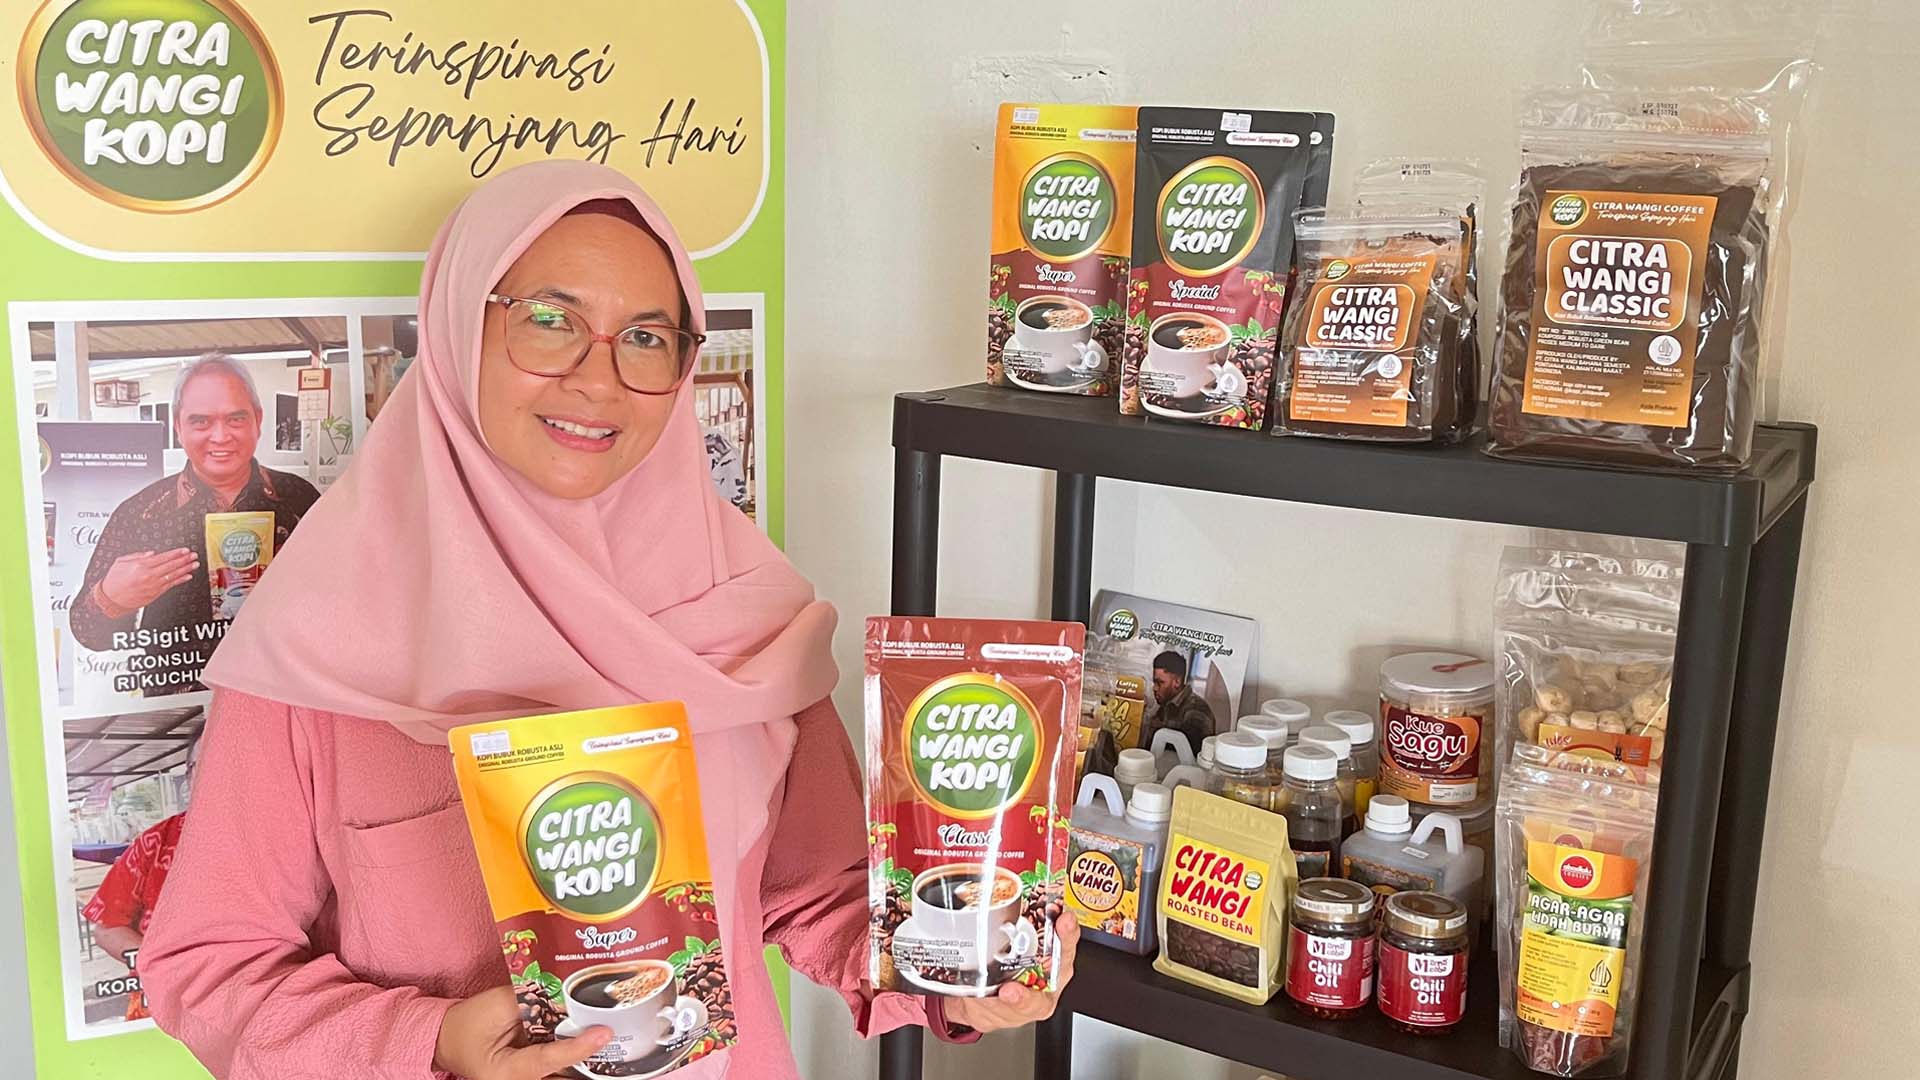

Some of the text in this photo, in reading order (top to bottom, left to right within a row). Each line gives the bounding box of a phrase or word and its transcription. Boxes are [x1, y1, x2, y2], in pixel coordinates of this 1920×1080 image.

[65, 19, 230, 67] CITRA
[307, 9, 615, 99] Terinspirasi
[55, 72, 244, 116] WANGI
[313, 83, 747, 178] Sepanjang Hari
[83, 119, 226, 168] KOPI
[1033, 175, 1100, 197] CITRA
[1176, 182, 1248, 206] CITRA
[1027, 198, 1101, 220] WANGI
[1553, 207, 1582, 215] WANGI
[1556, 200, 1582, 208] CITRA
[1592, 201, 1705, 215] CITRA WANGI COFFEE
[1166, 206, 1247, 230] WANGI
[1554, 213, 1577, 222] KOPI
[1031, 219, 1090, 241] KOPI
[1170, 230, 1234, 255] KOPI
[1374, 261, 1400, 269] WANGI
[1569, 240, 1668, 269] CITRA
[1035, 263, 1076, 284] Super
[1563, 266, 1671, 295] WANGI
[1168, 279, 1220, 300] Special
[1331, 287, 1397, 306] CITRA
[1216, 306, 1236, 314] COFFEE
[1560, 290, 1670, 318] CLASSIC
[1323, 306, 1399, 325] WANGI
[1317, 324, 1397, 342] CLASSIC
[1566, 365, 1602, 373] KALIMANTAN
[1109, 622, 1134, 632] WANGI
[1112, 615, 1134, 625] CITRA
[137, 626, 190, 648] Sigit
[1111, 629, 1130, 639] KOPI
[1151, 622, 1224, 645] CITRA WANGI KOPI
[131, 651, 205, 671] KONSUL
[118, 676, 135, 691] RI
[926, 704, 1017, 731] CITRA
[1406, 714, 1445, 735] Kue
[494, 751, 516, 759] BUBUK
[517, 745, 548, 755] ROBUSTA
[549, 743, 563, 751] ASLI
[919, 734, 1023, 760] WANGI
[1388, 720, 1468, 761] Sagu
[930, 761, 1012, 791] KOPI
[538, 797, 632, 841] CITRA
[938, 823, 1000, 847] Classi
[535, 827, 642, 870] WANGI
[913, 848, 942, 857] ORIGINAL
[942, 849, 972, 858] ROBUSTA
[1003, 851, 1024, 859] COFFEE
[1077, 857, 1115, 879] CITRA
[1175, 845, 1245, 889] CITRA
[554, 858, 636, 900] KOPI
[1072, 870, 1119, 895] WANGI
[1170, 872, 1251, 919] WANGI
[1167, 899, 1254, 936] ROASTED BEAN
[1531, 895, 1625, 927] AGAR-AGAR
[1531, 911, 1568, 930] LIDAH
[575, 926, 637, 950] Super
[1572, 921, 1622, 941] BUAYA
[585, 952, 614, 960] ROBUSTA
[616, 945, 645, 958] GROUND
[645, 936, 669, 951] COFFEE
[1308, 959, 1343, 976] Chili
[1315, 974, 1339, 988] Oil
[1409, 978, 1445, 993] Chili
[1416, 991, 1441, 1005] Oil
